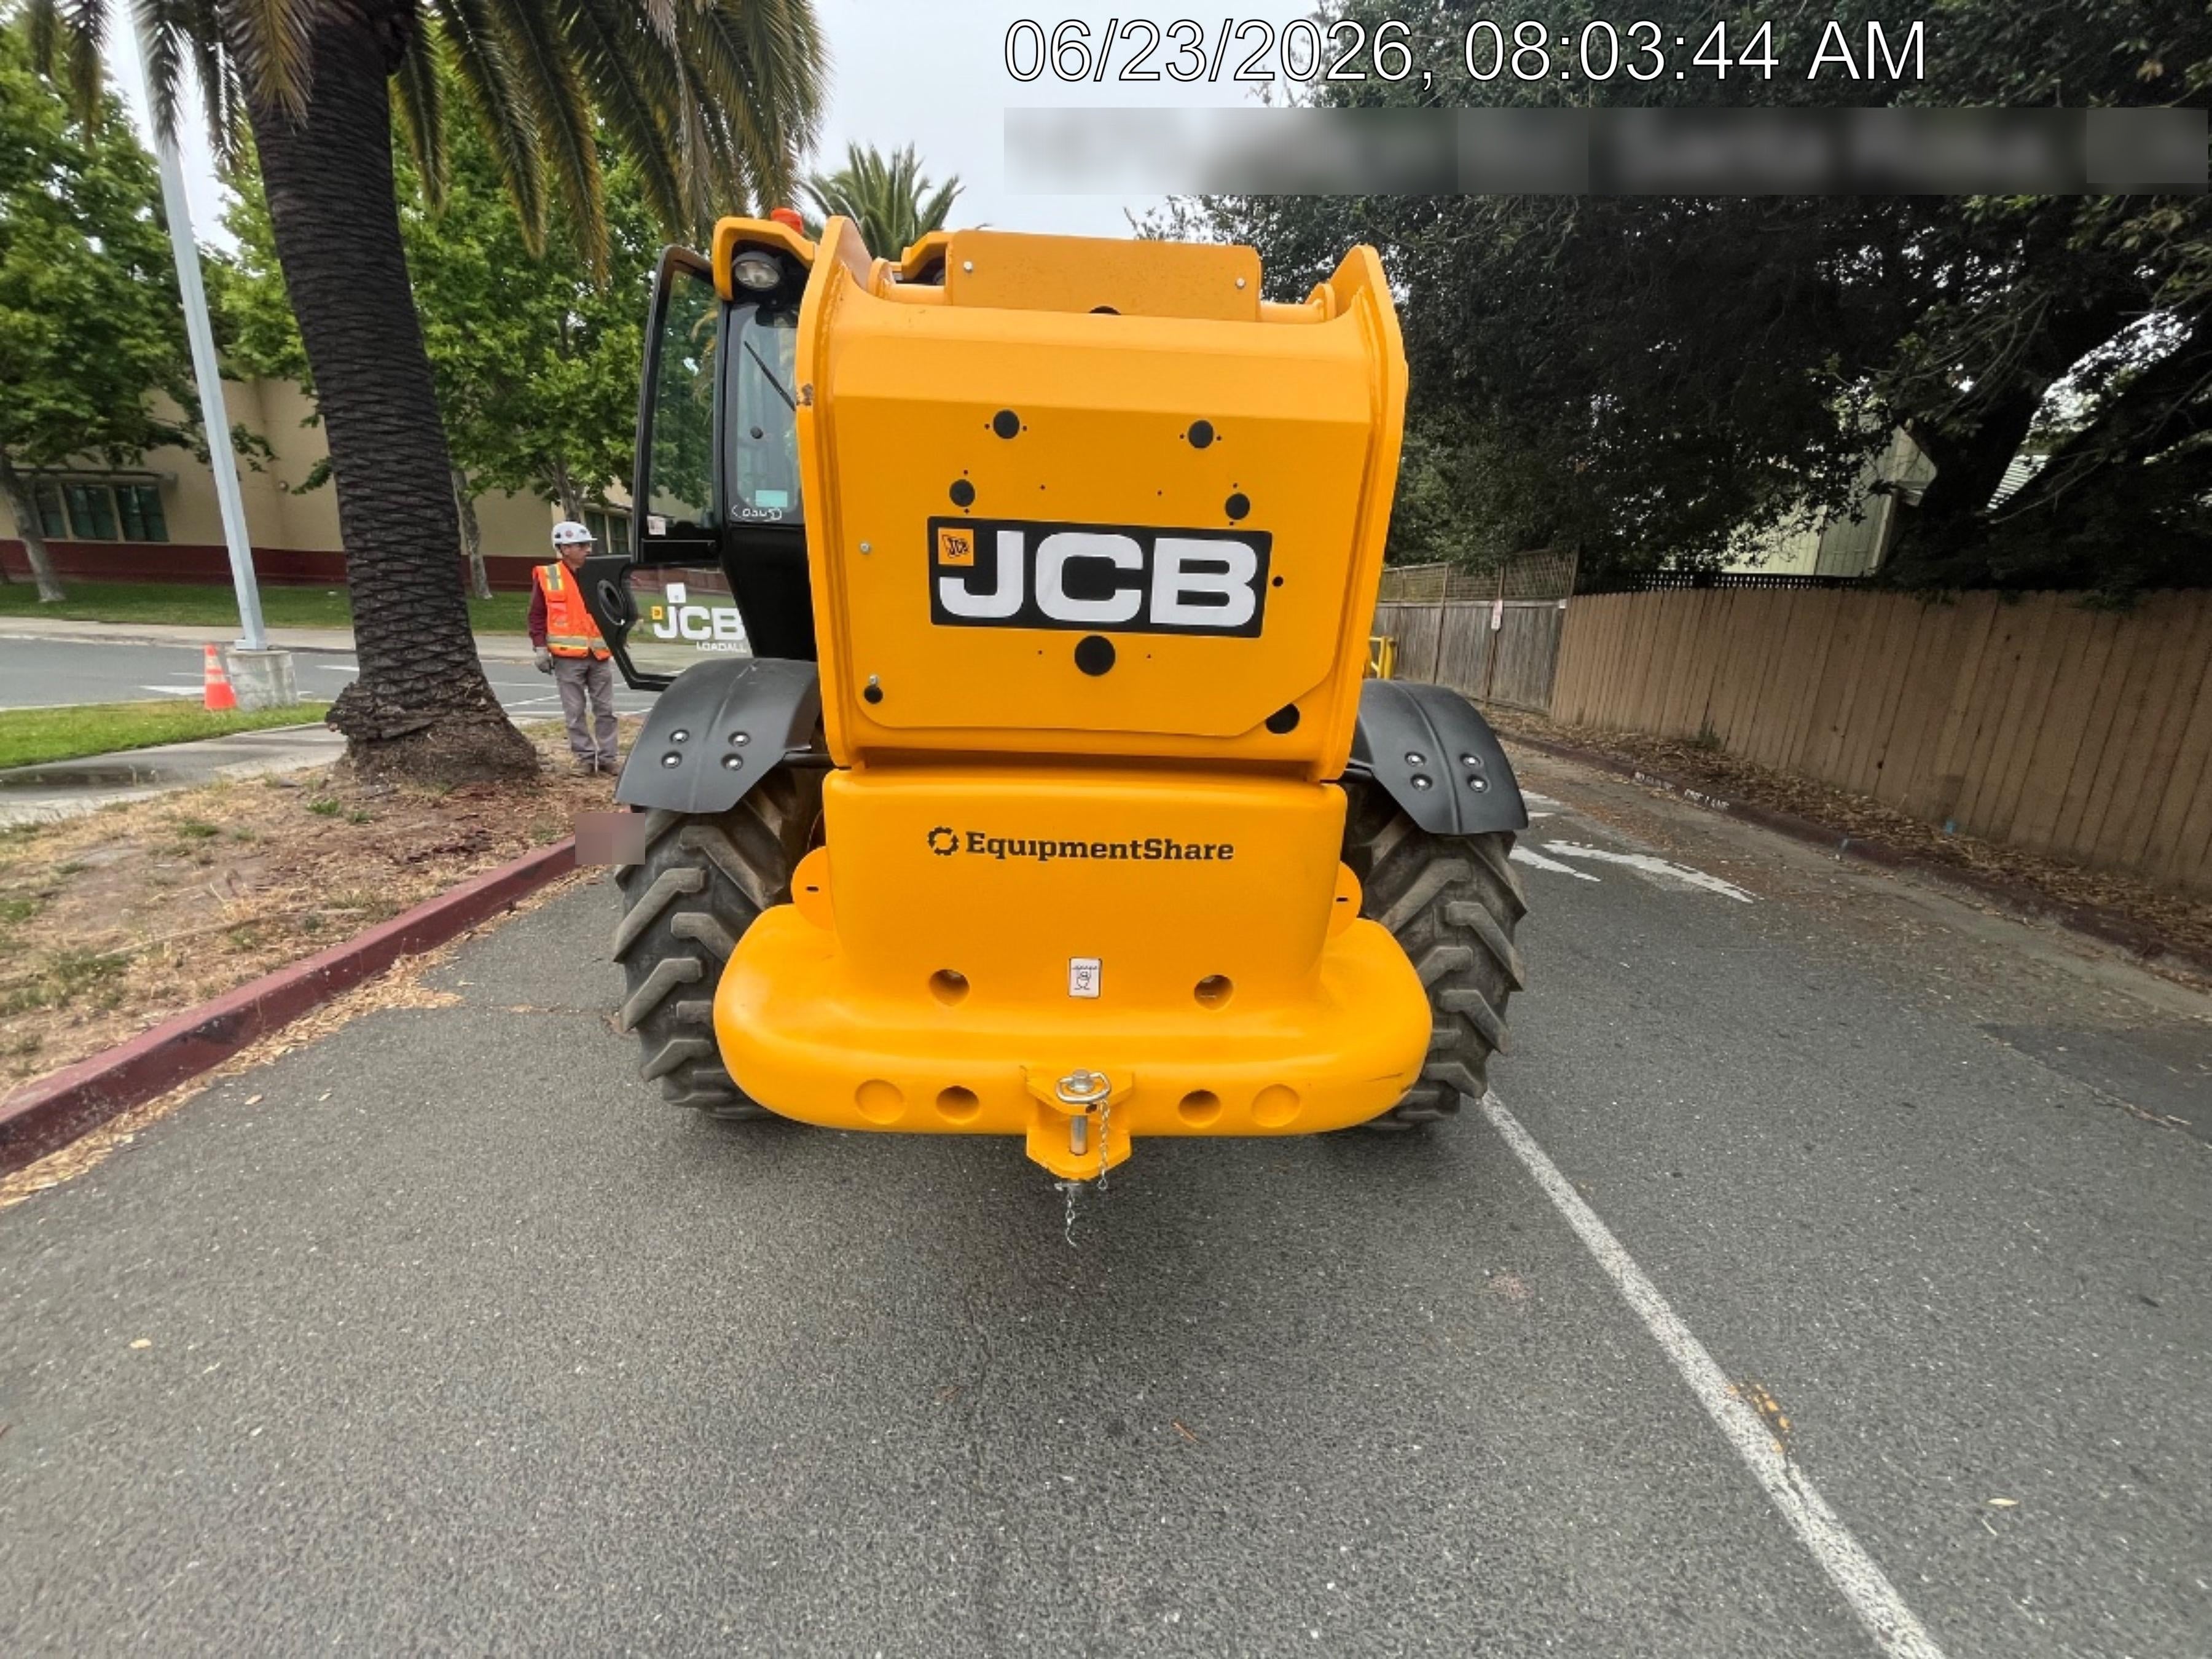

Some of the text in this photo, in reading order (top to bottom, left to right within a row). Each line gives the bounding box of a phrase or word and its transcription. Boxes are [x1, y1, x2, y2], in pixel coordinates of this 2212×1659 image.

[939, 530, 1258, 627] JCB
[653, 606, 746, 640] JCB
[965, 831, 1234, 861] EquipmentShare
